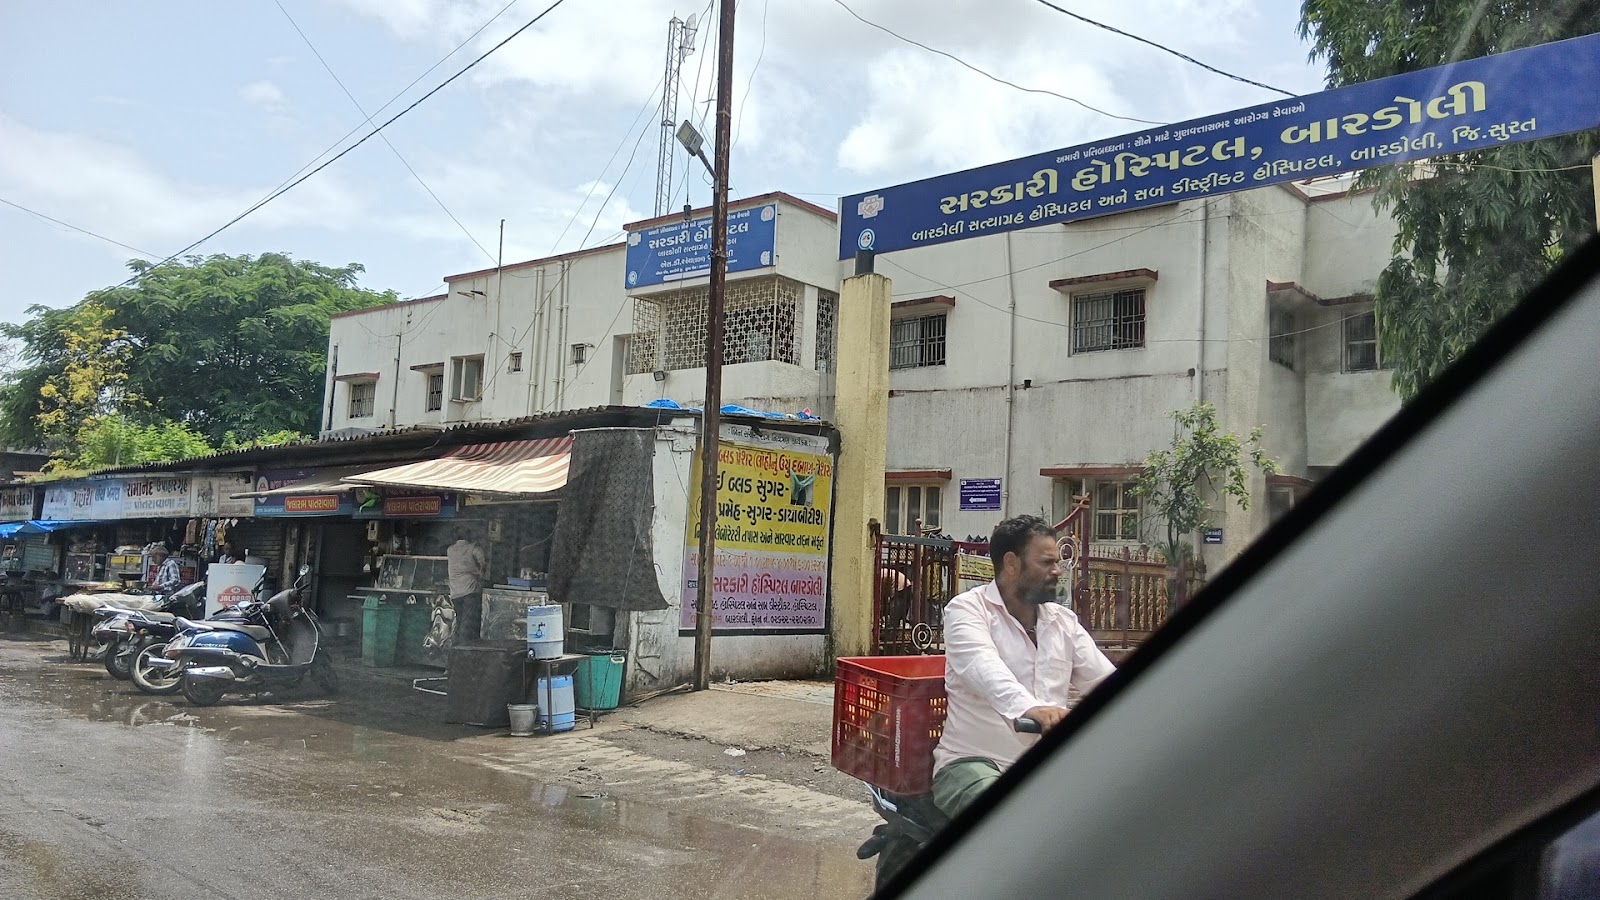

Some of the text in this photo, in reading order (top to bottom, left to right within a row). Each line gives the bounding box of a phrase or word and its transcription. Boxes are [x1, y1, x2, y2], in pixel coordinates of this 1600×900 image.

[1056, 151, 1080, 164] અમારી
[1134, 134, 1151, 147] સૌને
[1155, 131, 1170, 142] માટે
[1173, 120, 1230, 141] ગુણવત્તાસભર
[1234, 112, 1269, 125] આરોગ્ય
[1272, 102, 1305, 118] સેવાઓ
[940, 80, 1486, 215] સરકારી હોસ્પિટલ, બારડોલી
[911, 220, 965, 242] બારડોલી
[968, 212, 1025, 232] સત્યાગ્રહ
[1029, 199, 1092, 222] હોસ્પિટલ
[1097, 188, 1127, 207] અને
[1133, 185, 1165, 202] સબ
[1171, 171, 1245, 194] ડીસ્ટ્રીકટ
[1253, 154, 1341, 181] હોસ્પિટલ,
[1351, 133, 1443, 162] બારડોલી,
[648, 230, 690, 249] સરકારી
[728, 477, 752, 493] બ્લડ
[760, 529, 773, 545] અને
[714, 572, 749, 594] સરકારી
